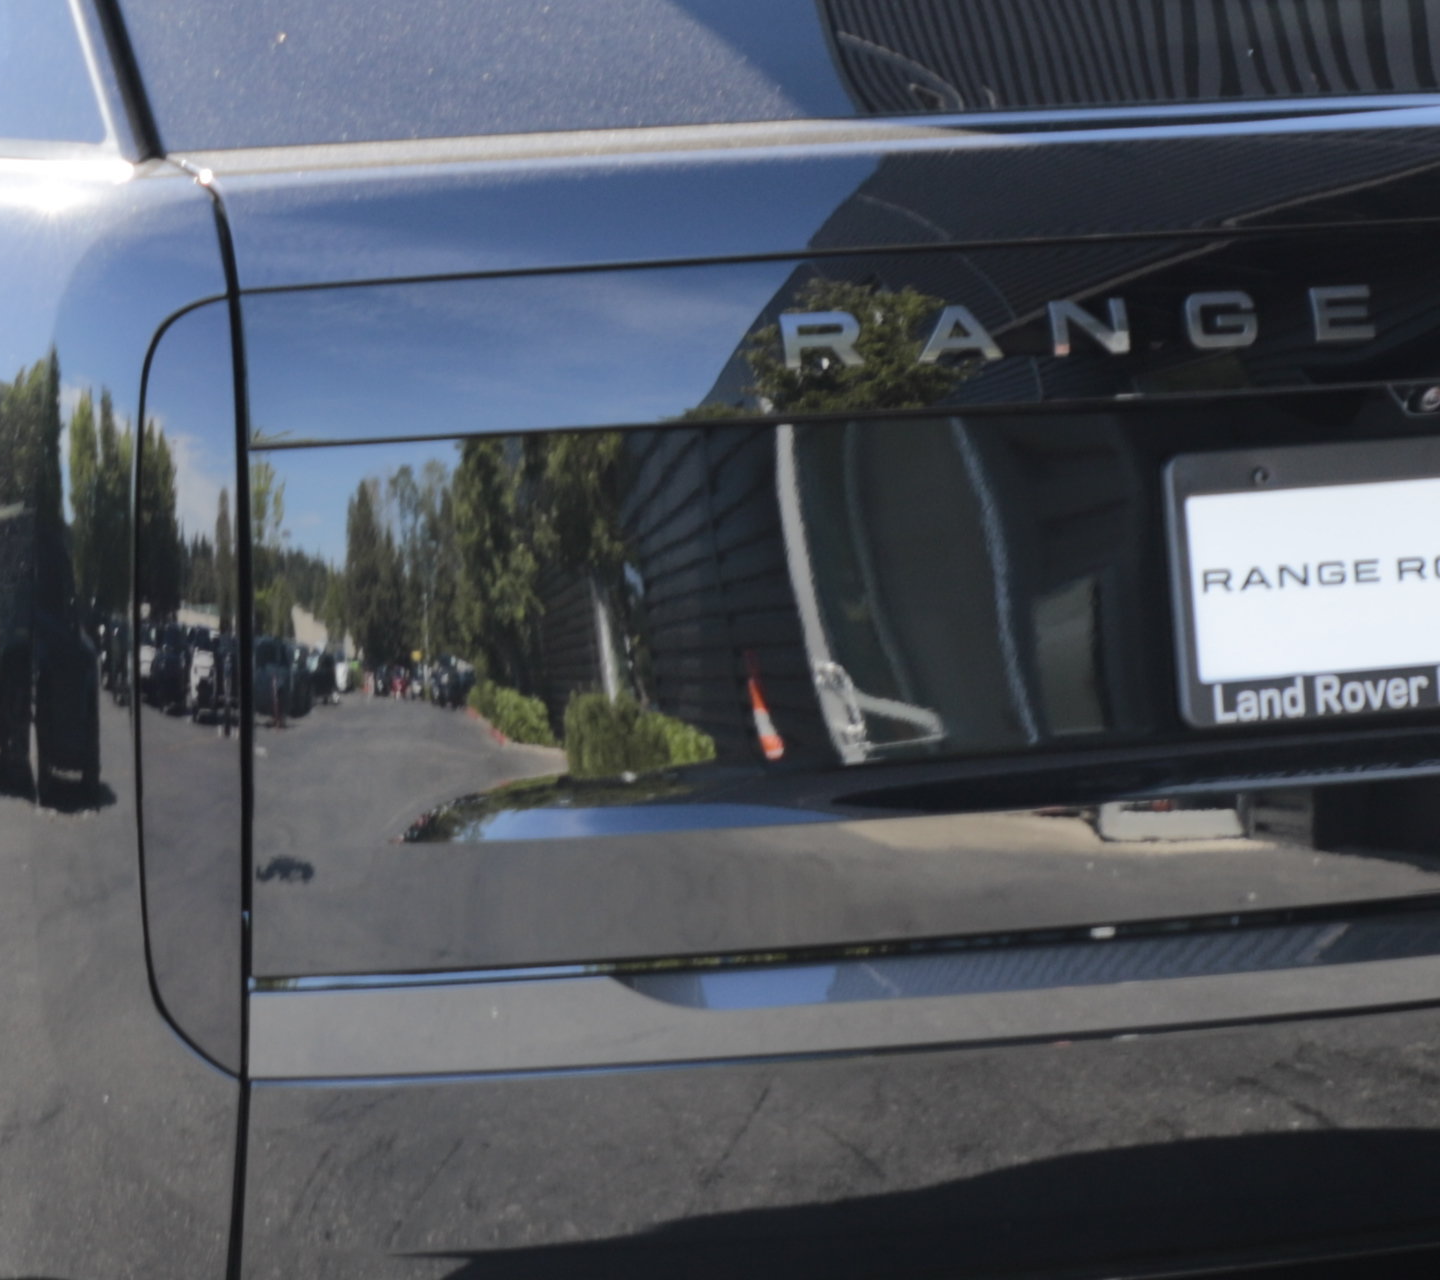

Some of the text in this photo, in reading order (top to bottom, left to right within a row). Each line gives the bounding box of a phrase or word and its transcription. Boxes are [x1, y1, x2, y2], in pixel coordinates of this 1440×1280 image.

[782, 284, 1377, 370] RANGE
[1203, 559, 1380, 593] RANGE
[1212, 675, 1306, 724] Land
[1314, 674, 1428, 716] Rover
